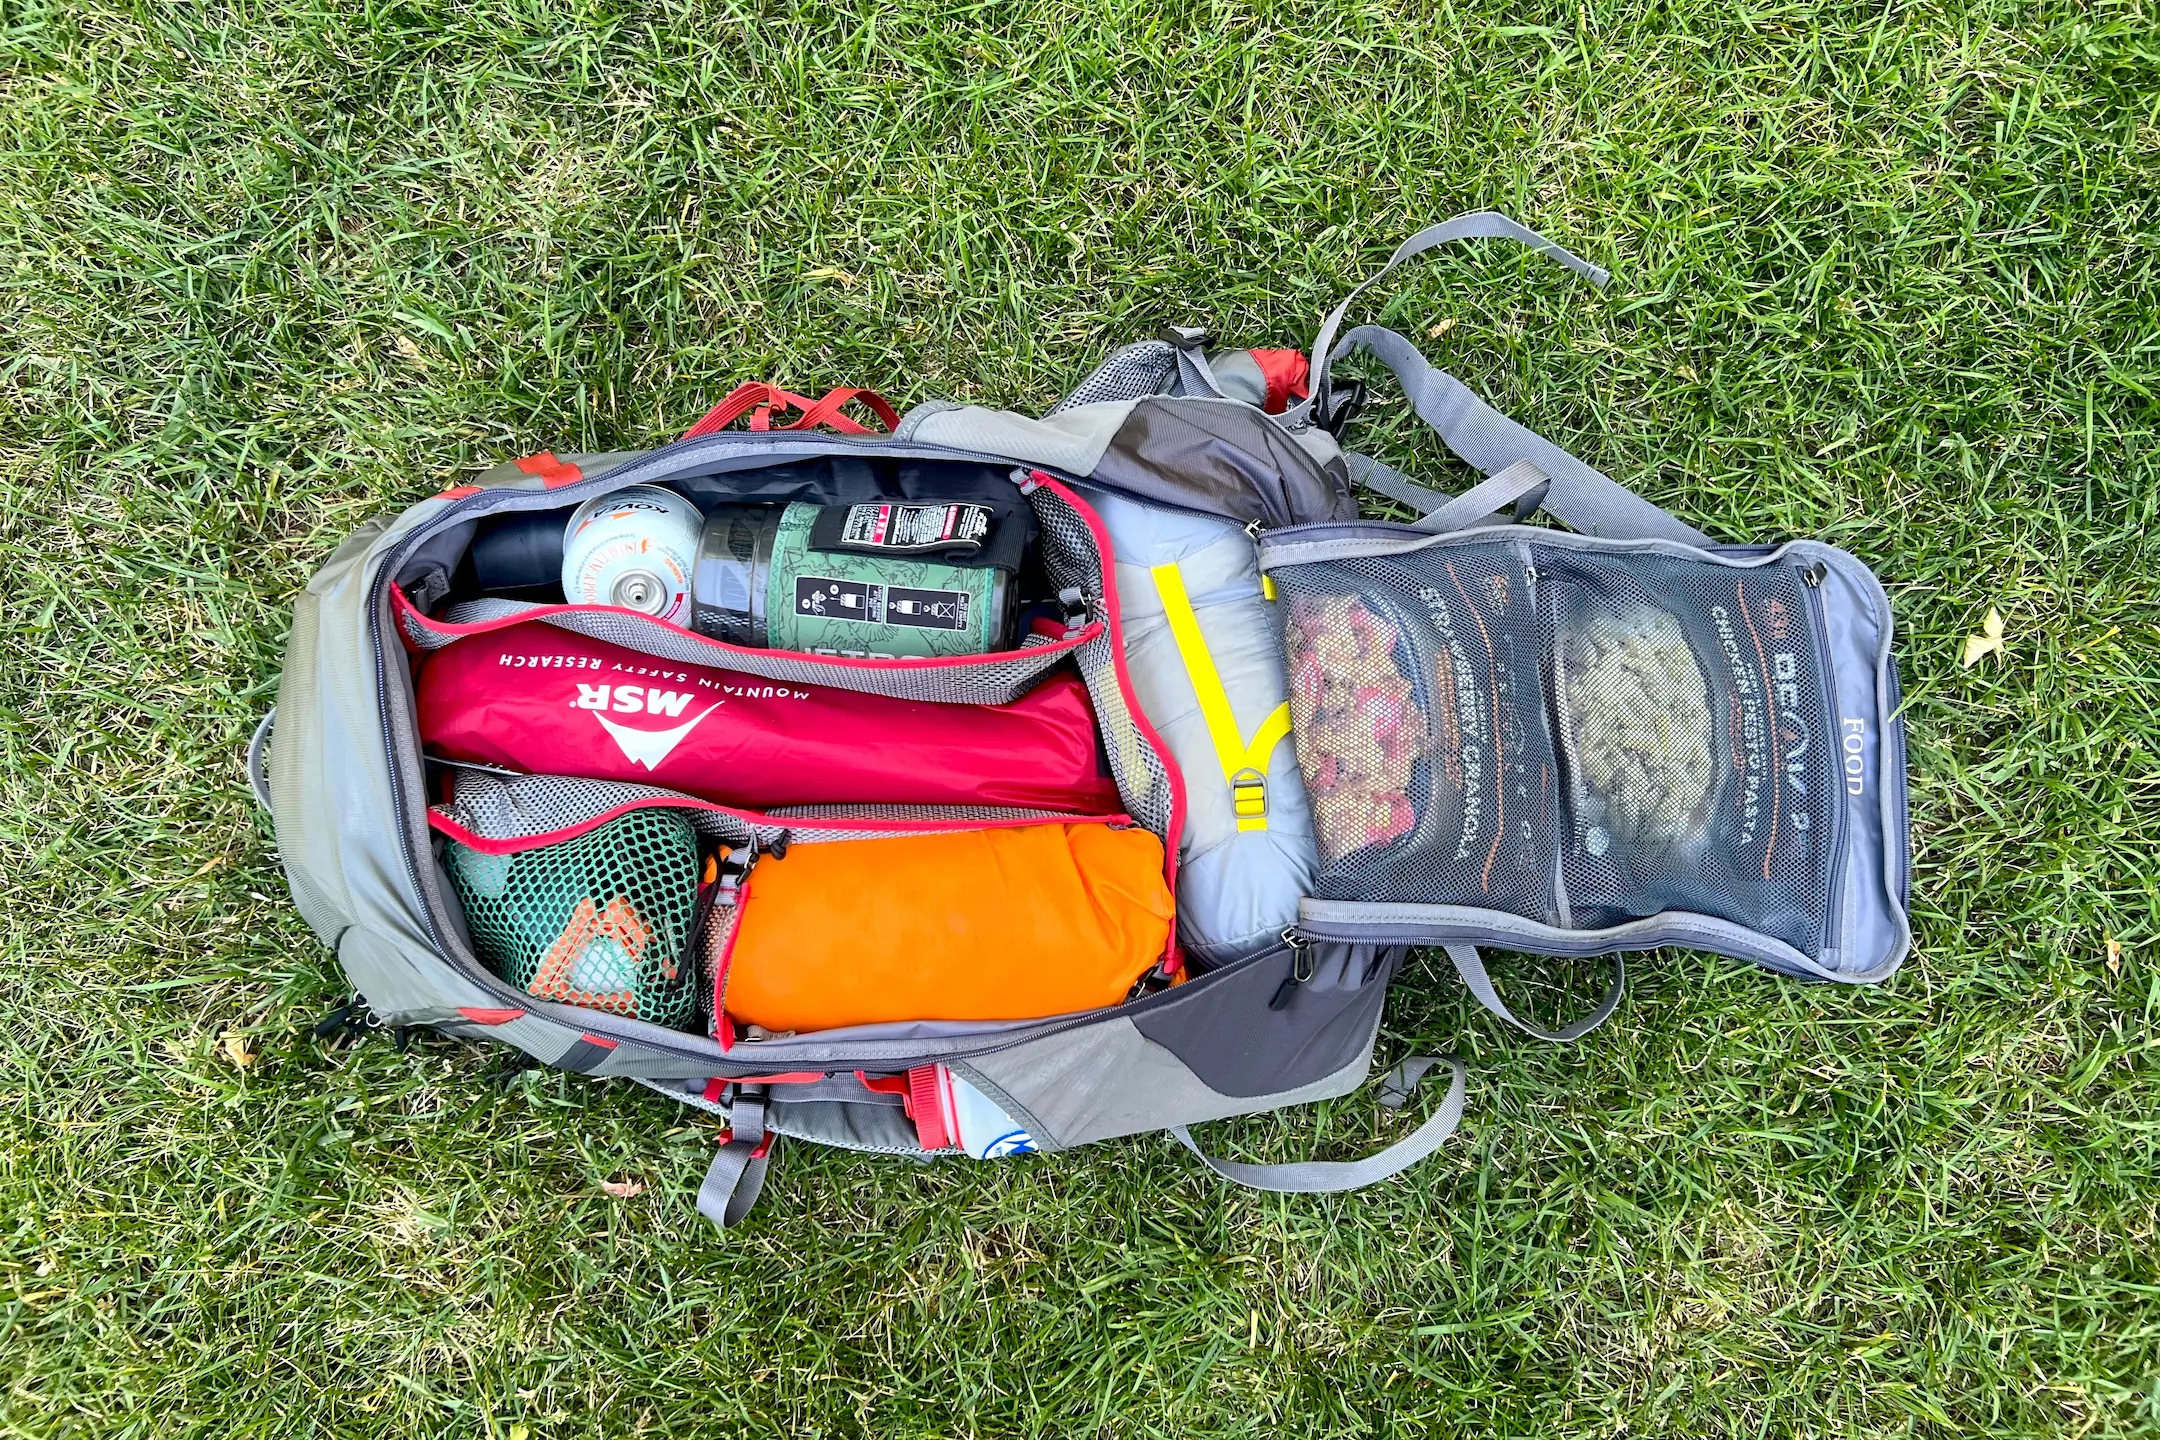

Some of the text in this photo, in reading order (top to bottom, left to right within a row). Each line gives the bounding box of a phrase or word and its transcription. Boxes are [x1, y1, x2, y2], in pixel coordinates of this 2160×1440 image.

[593, 502, 669, 519] KOVEA
[497, 653, 810, 700] MOUNTAIN SAFETY RESEARCH
[1711, 606, 1752, 694] CHICKEN
[1419, 585, 1480, 738] STRAWBERRY
[1453, 745, 1482, 862] GRANOLA
[1742, 699, 1760, 770] PESTO
[1843, 716, 1866, 796] FOOD
[1740, 776, 1760, 846] PASTA
